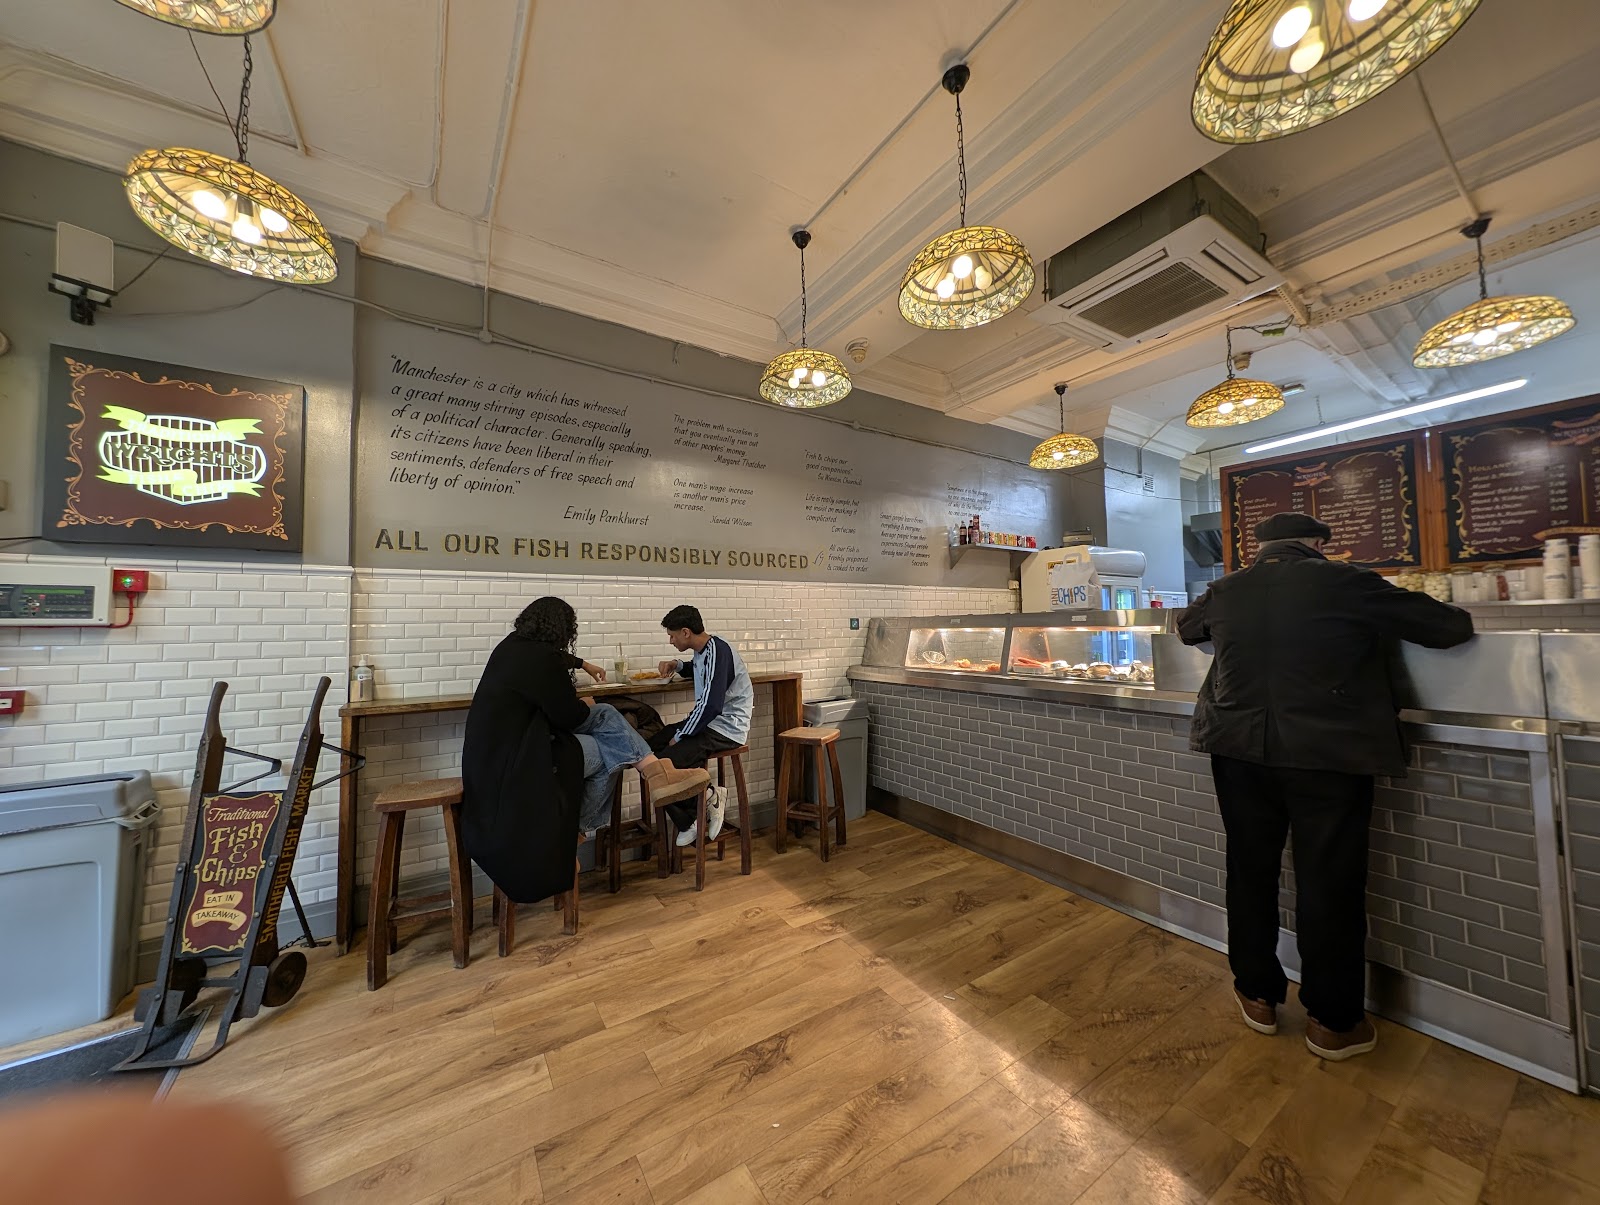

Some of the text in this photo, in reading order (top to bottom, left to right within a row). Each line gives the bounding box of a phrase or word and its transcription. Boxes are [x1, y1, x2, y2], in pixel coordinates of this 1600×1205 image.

[473, 377, 484, 389] is
[488, 382, 497, 392] a
[500, 384, 521, 398] city
[526, 388, 558, 403] which
[560, 394, 579, 407] has
[583, 400, 628, 417] witnessed
[391, 385, 631, 438] a great many stirring episodes, especially
[391, 404, 411, 418] of
[410, 410, 420, 420] a
[423, 413, 480, 428] political
[484, 420, 547, 440] character.
[552, 428, 605, 451] Generally
[674, 414, 684, 424] The
[687, 419, 710, 428] problem
[727, 427, 752, 437] socialism
[674, 427, 688, 435] that
[704, 433, 735, 445] eventually
[107, 442, 256, 474] WRIGHTS
[391, 425, 613, 468] its citizens have been liberal in their
[391, 450, 635, 489] sentiments, defenders of free speech and
[714, 455, 766, 469] Margaret Thatcher
[390, 468, 438, 489] liberty
[444, 474, 460, 488] of
[674, 478, 686, 487] One
[710, 485, 726, 493] wage
[729, 486, 753, 495] increase
[674, 490, 679, 498] is
[683, 492, 708, 501] another
[731, 497, 746, 505] price
[674, 501, 705, 511] increase.
[564, 506, 649, 526] Emily Pankhurst
[375, 528, 808, 569] ALL OUR FISH RESPONSIBLY SOURCED
[1058, 586, 1086, 605] CHIPS
[207, 805, 275, 823] Traditional
[209, 820, 263, 855] Fish
[229, 840, 258, 864] &
[260, 766, 315, 944] SMITHFIELD FISH MARKET
[201, 858, 257, 887] Chips
[206, 894, 235, 904] EAT IN
[196, 910, 239, 920] TAKEAWAY
